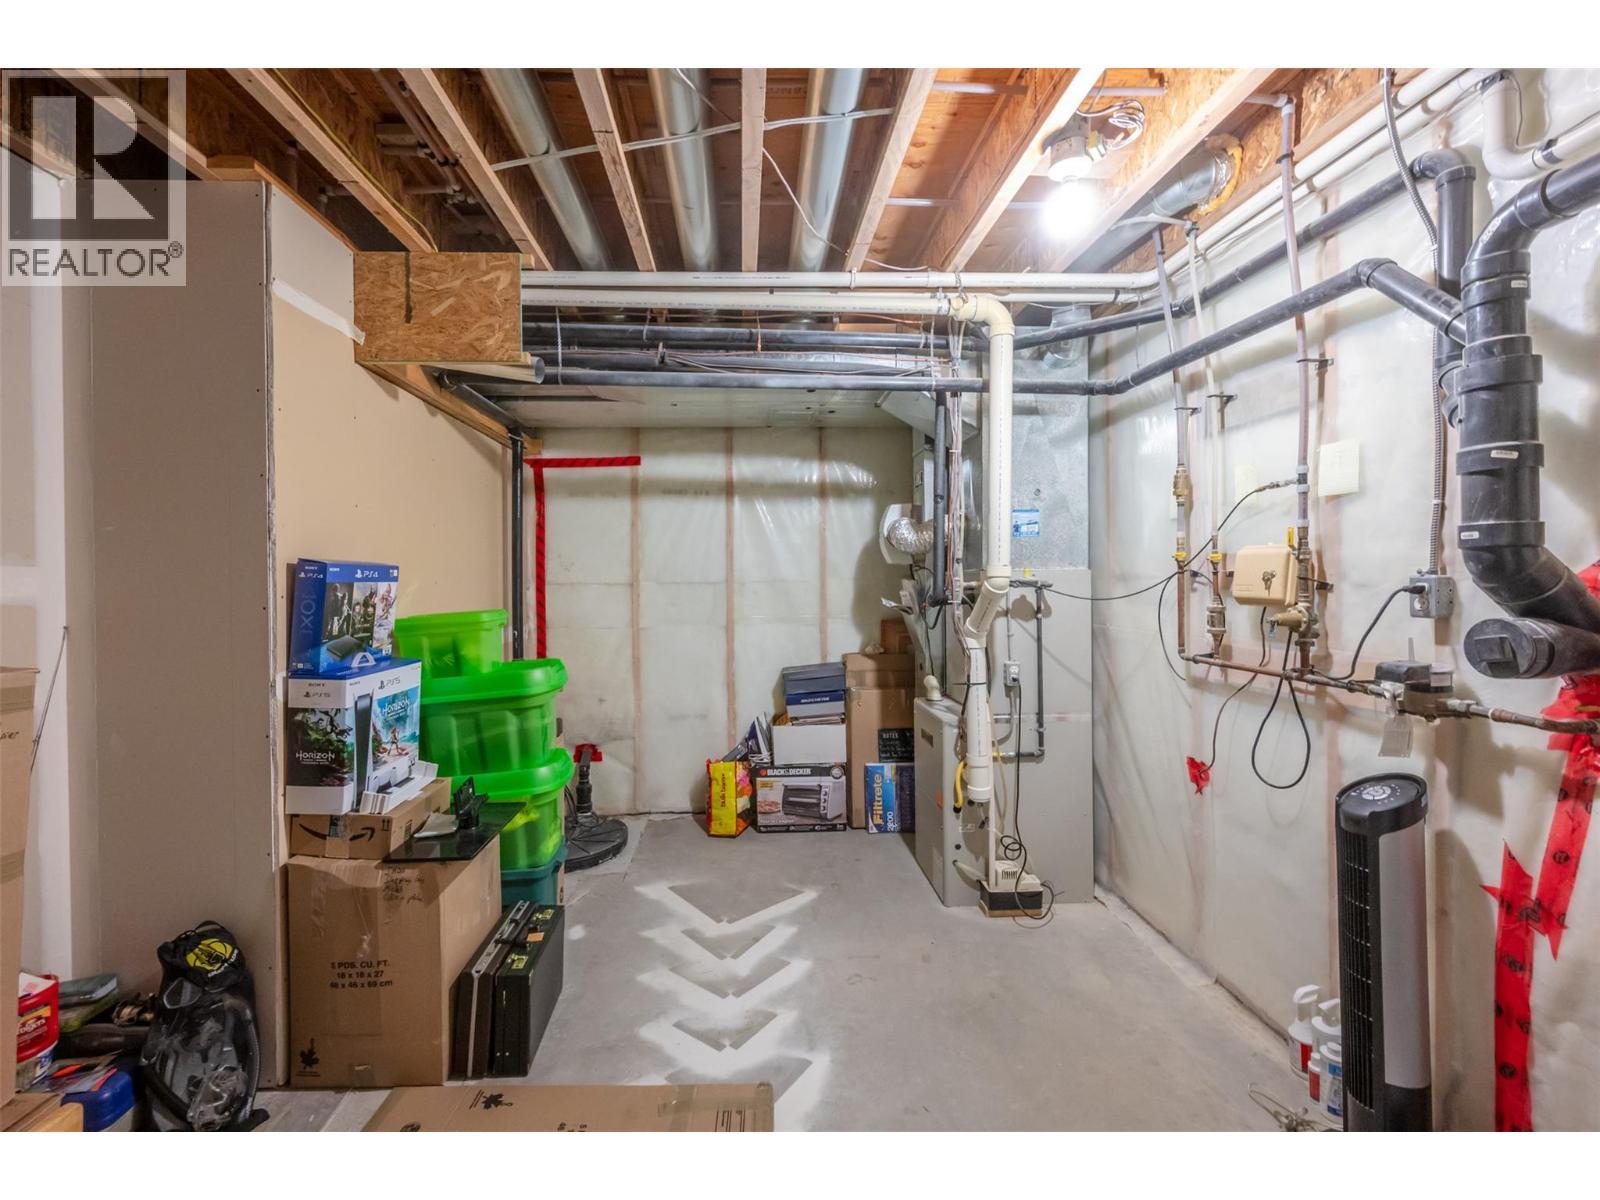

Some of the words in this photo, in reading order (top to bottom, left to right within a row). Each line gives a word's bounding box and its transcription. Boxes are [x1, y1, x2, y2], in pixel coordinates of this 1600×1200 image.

[364, 570, 379, 578] PS4
[872, 773, 884, 825] Filtrete
[373, 970, 385, 978] 27
[379, 980, 393, 988] cm
